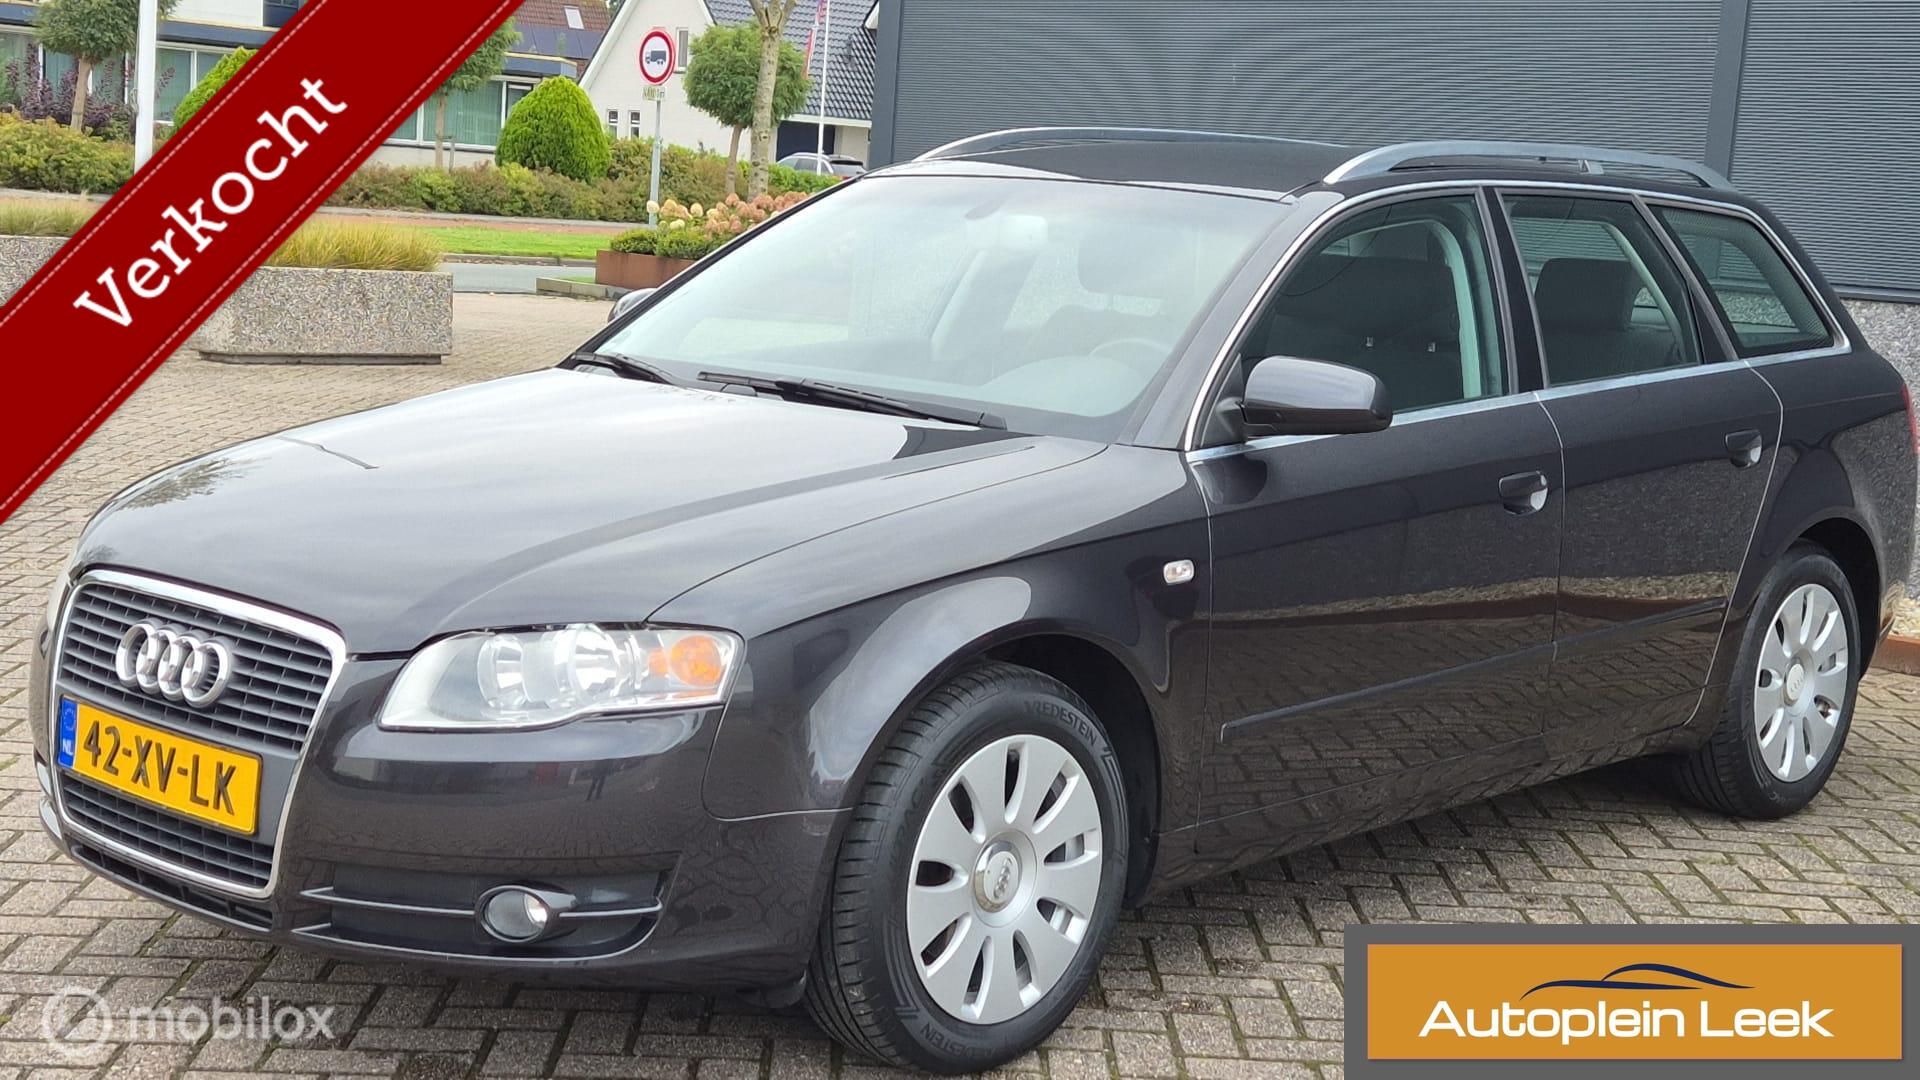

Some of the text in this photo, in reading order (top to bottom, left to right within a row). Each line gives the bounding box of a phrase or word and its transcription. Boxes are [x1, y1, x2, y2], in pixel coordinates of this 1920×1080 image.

[1023, 700, 1098, 747] VREDESTEIN
[62, 738, 75, 757] NL
[83, 719, 237, 817] 42-XV-LK
